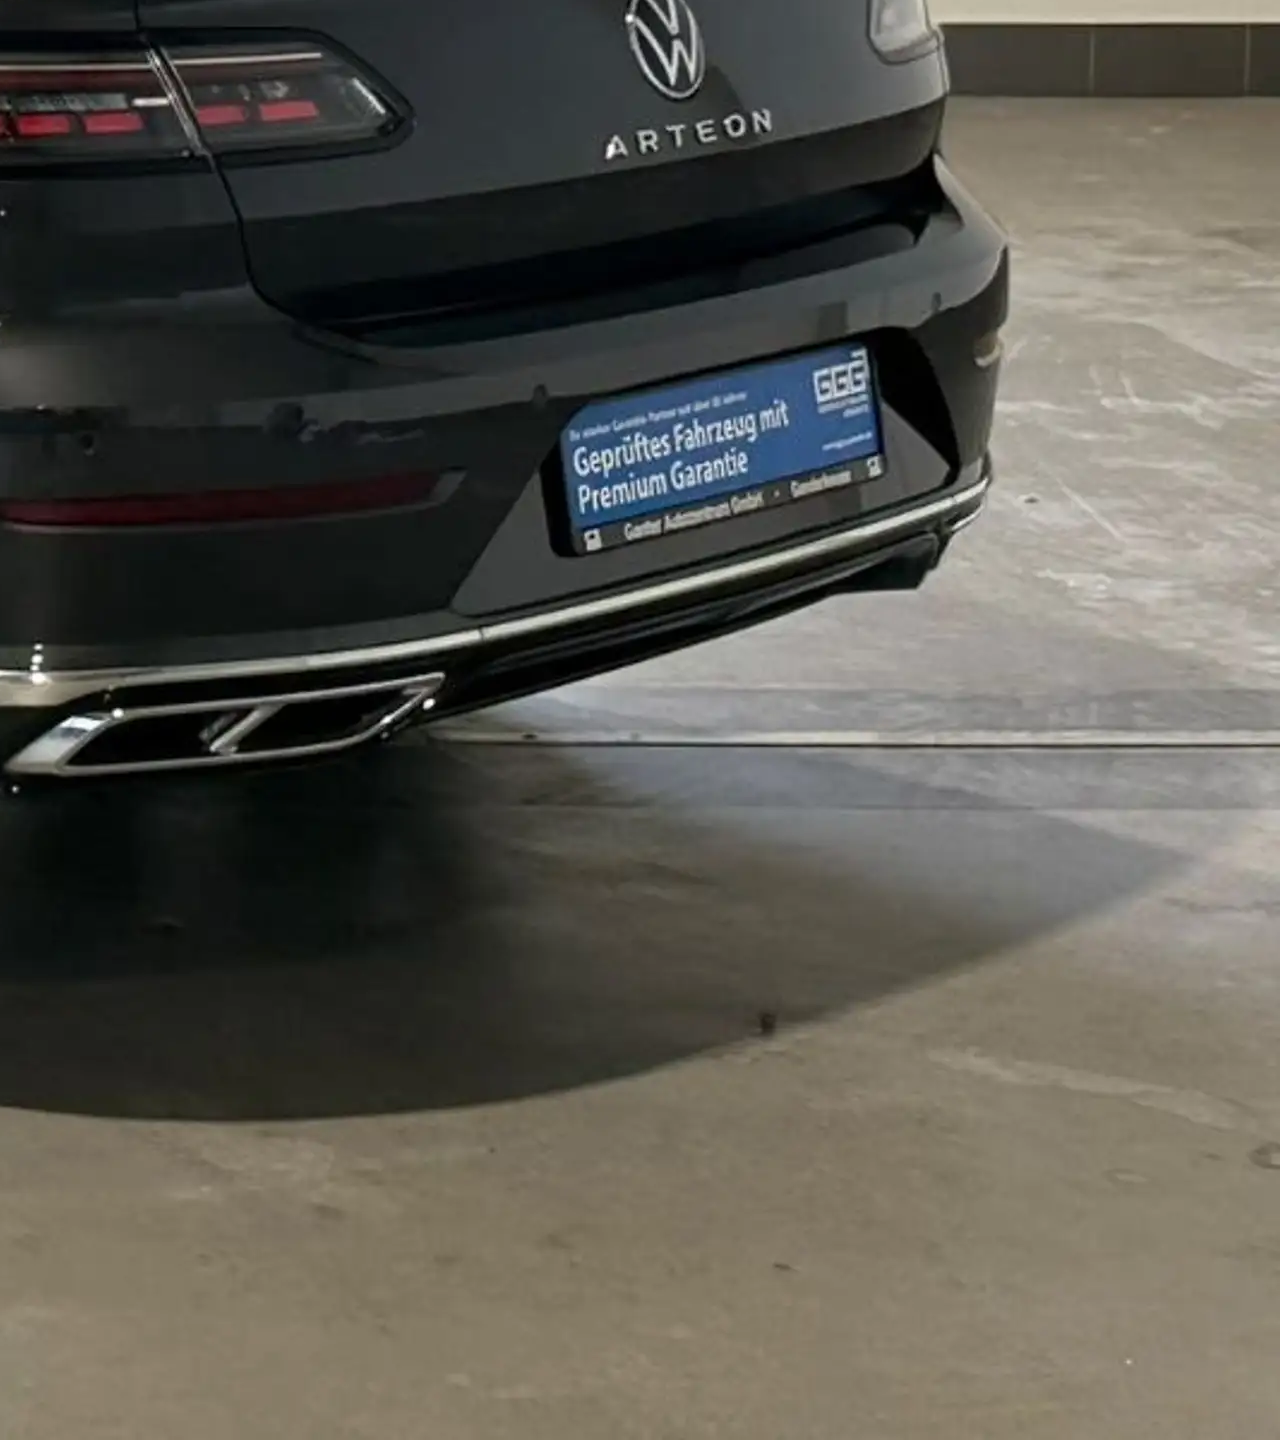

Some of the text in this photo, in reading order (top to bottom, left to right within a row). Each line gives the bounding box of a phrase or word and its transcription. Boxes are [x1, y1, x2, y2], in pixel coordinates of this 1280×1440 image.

[604, 107, 774, 160] ARTEON
[572, 431, 671, 478] Geprüftes
[672, 417, 759, 453] Fahrzeug
[759, 397, 790, 432] mit
[577, 472, 668, 515] Premium
[669, 447, 749, 490] Garantie
